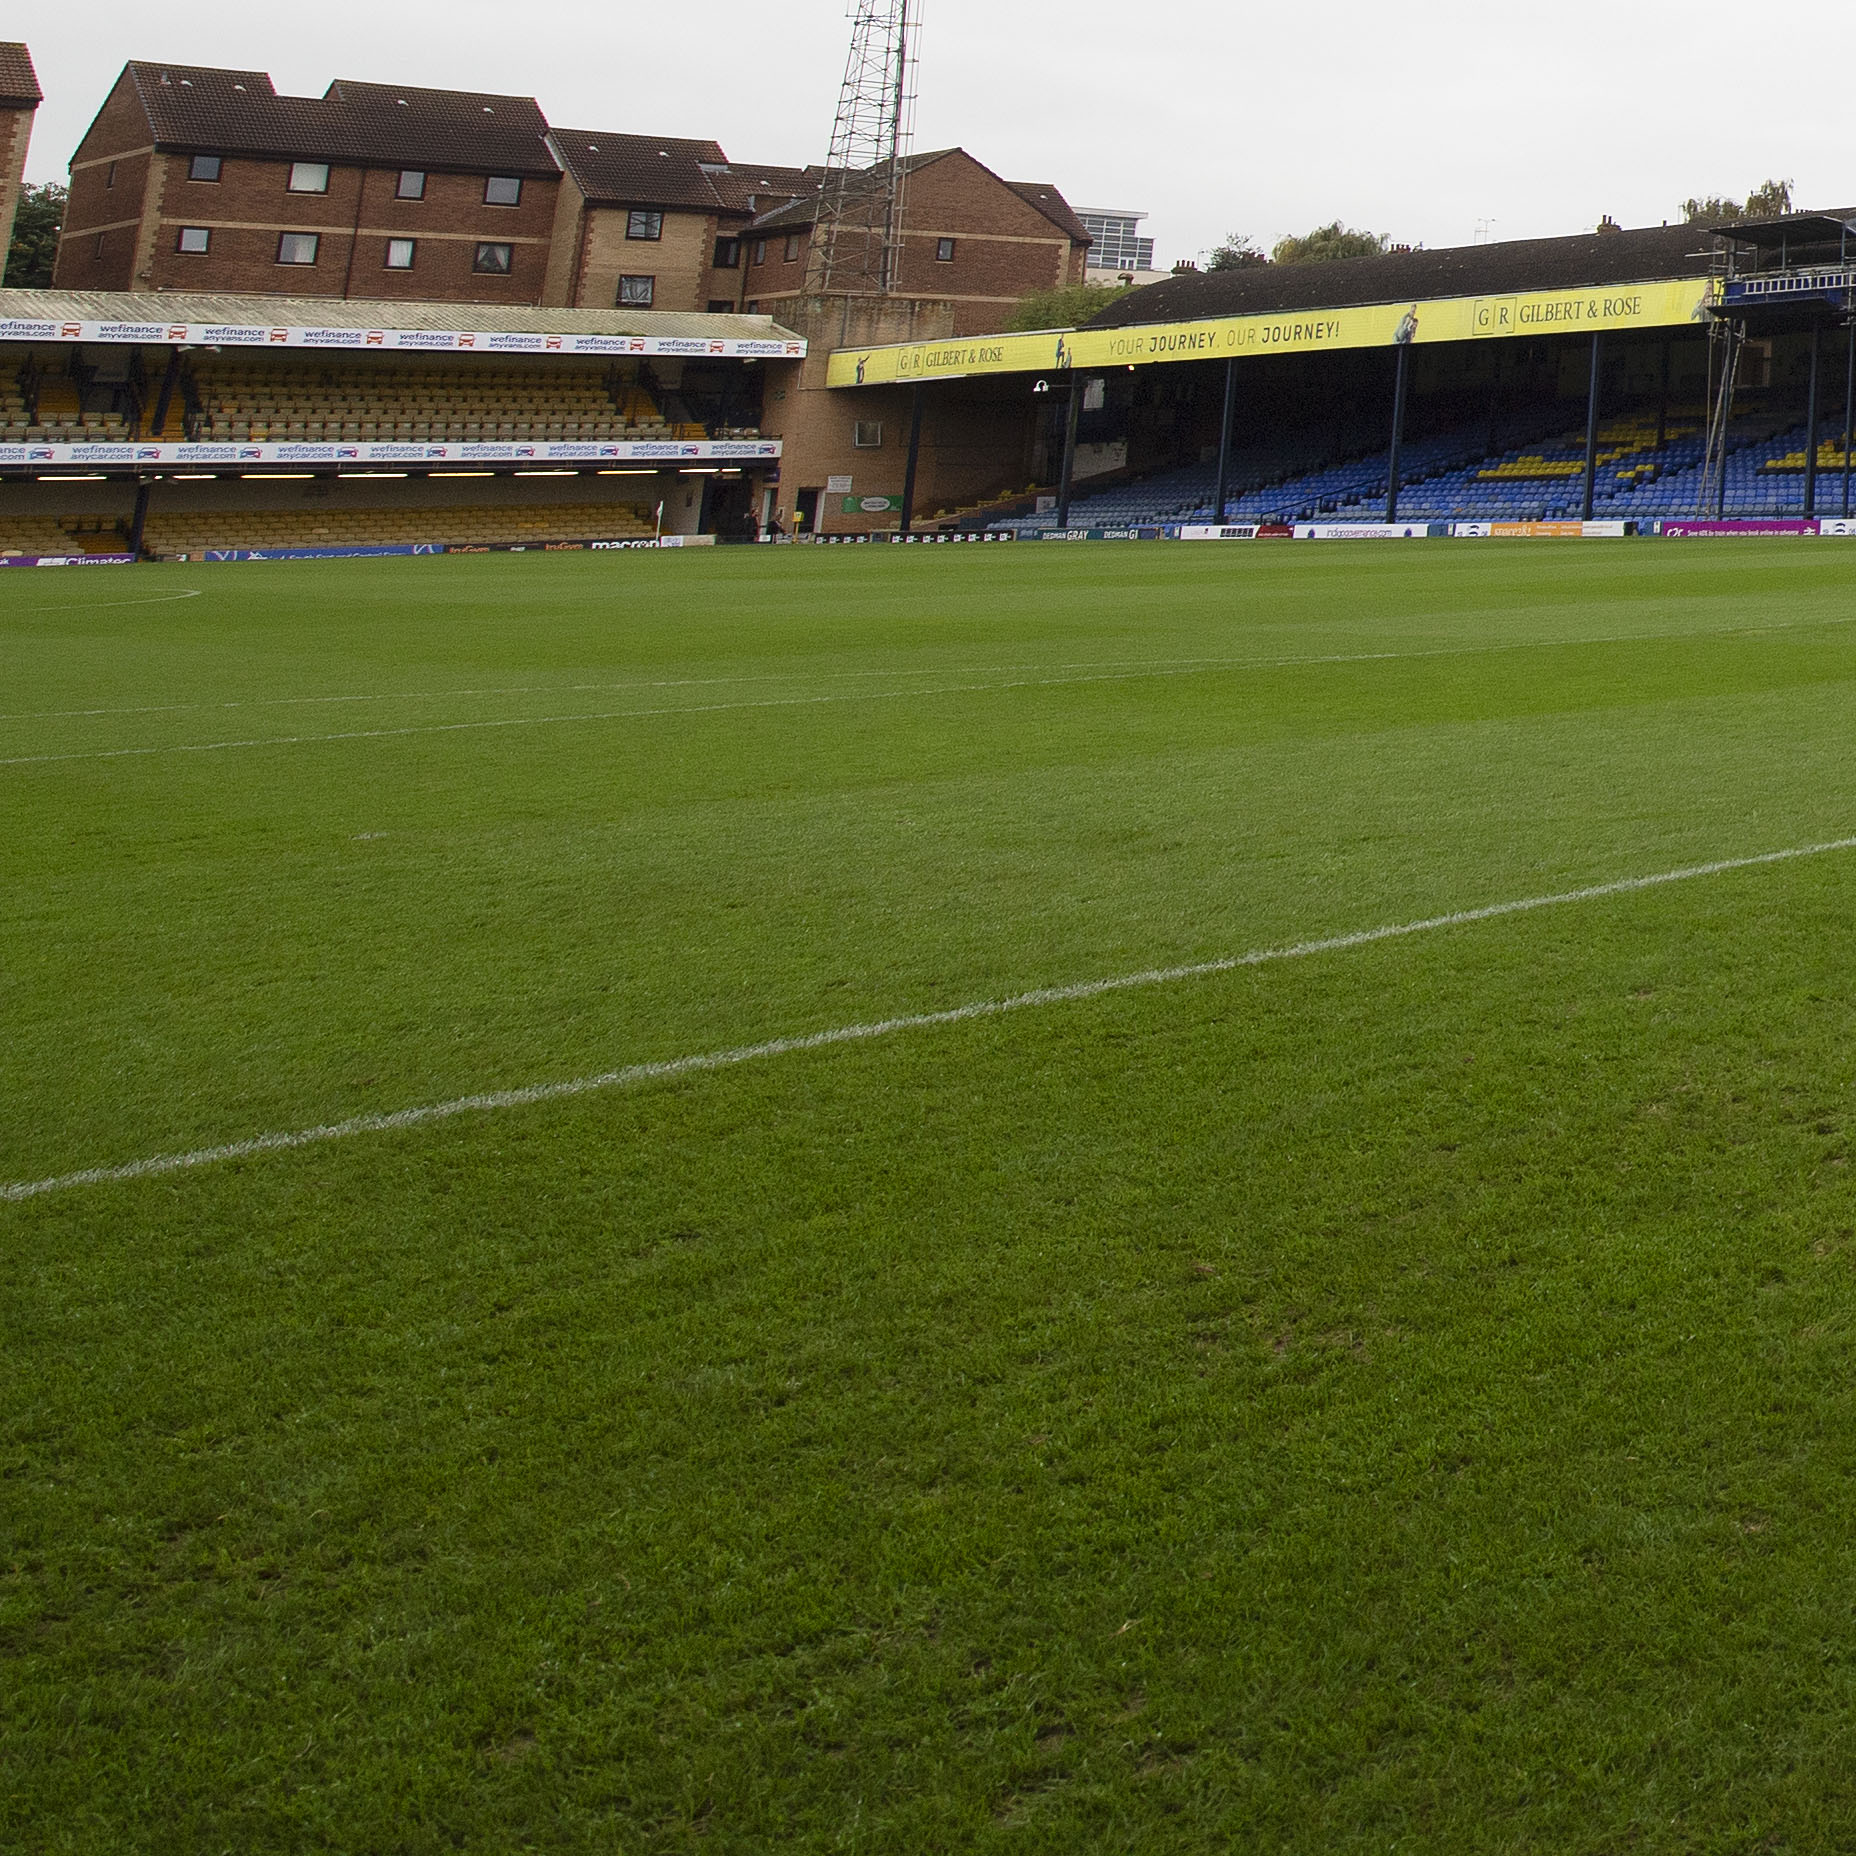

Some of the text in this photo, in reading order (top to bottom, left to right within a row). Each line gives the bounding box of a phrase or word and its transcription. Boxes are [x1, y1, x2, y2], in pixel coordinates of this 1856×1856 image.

[1478, 296, 1642, 326] G R GILBERT & ROSE
[100, 324, 163, 335] wefinance
[205, 327, 265, 337] wefinance
[304, 330, 362, 340] wefinance
[399, 332, 454, 342] wefinance
[489, 335, 542, 344] wefinance
[1109, 338, 1144, 356] YOUR
[1227, 328, 1257, 347] OUR
[1261, 320, 1341, 344] JOURNEY!
[576, 337, 627, 347] wefinance
[657, 340, 707, 348] wefinance
[735, 342, 782, 350] wefinance
[926, 349, 967, 367] GILBERT
[969, 348, 976, 364] &
[978, 346, 1004, 363] ROSE
[72, 444, 134, 455] wefinance
[178, 444, 237, 454] wefinance
[278, 444, 335, 453] wefinance
[370, 444, 425, 453] wefinance
[461, 444, 513, 453] wefinance
[549, 443, 598, 452] wefinance
[632, 443, 679, 452] wefinance
[711, 443, 756, 452] wefinance
[1067, 530, 1088, 541] GRAY
